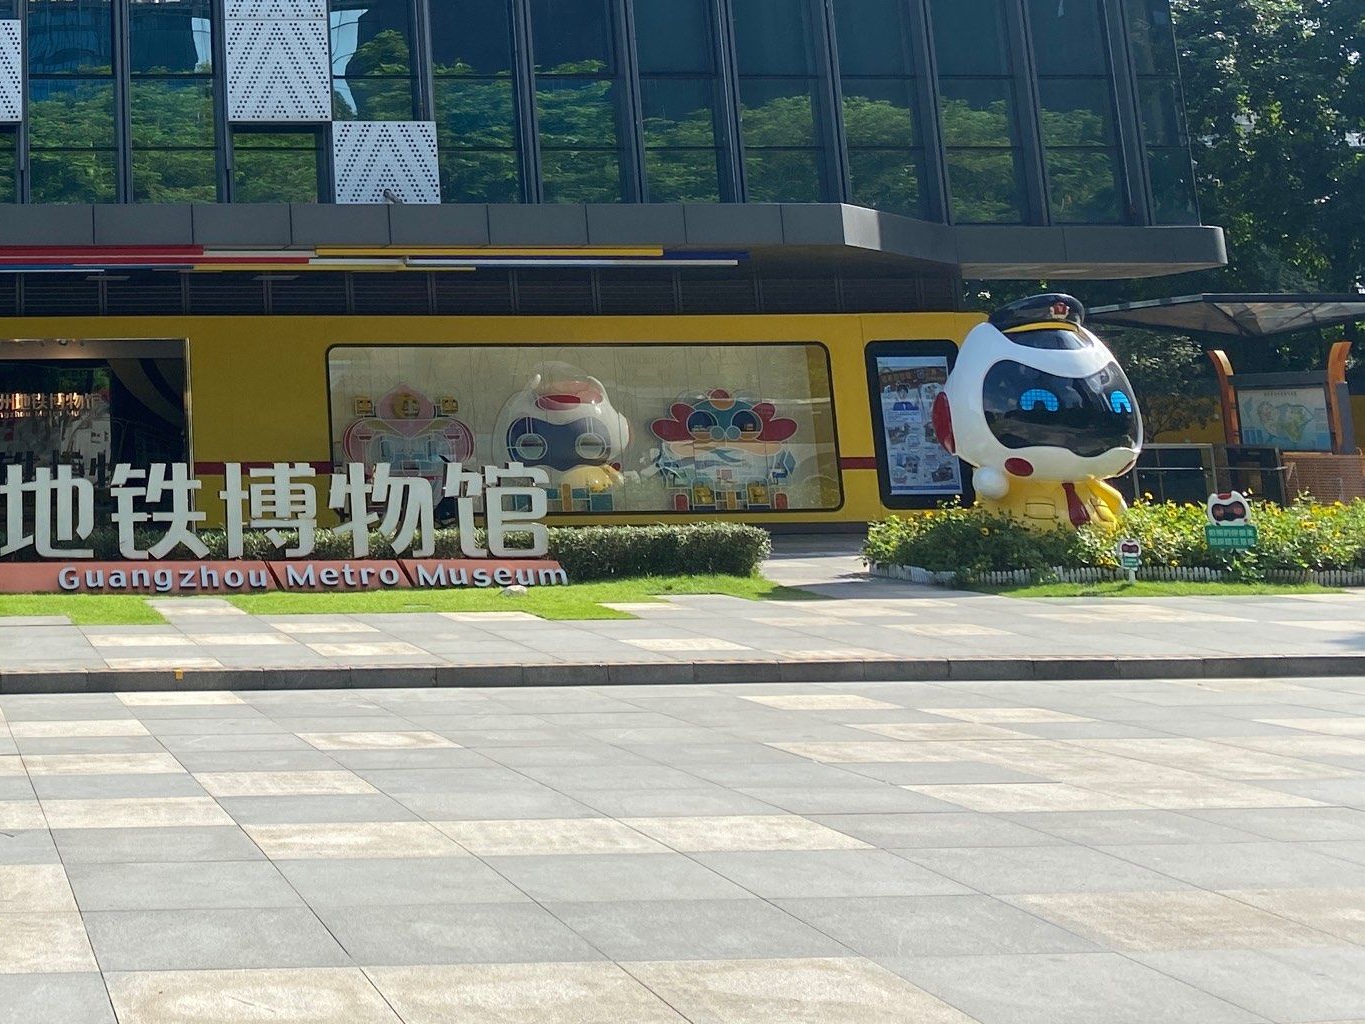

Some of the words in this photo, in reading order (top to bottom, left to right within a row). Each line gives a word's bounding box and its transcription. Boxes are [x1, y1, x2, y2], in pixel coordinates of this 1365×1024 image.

[58, 566, 269, 592] Guangzhou
[285, 564, 400, 588] Metro
[416, 562, 569, 586] Museum
